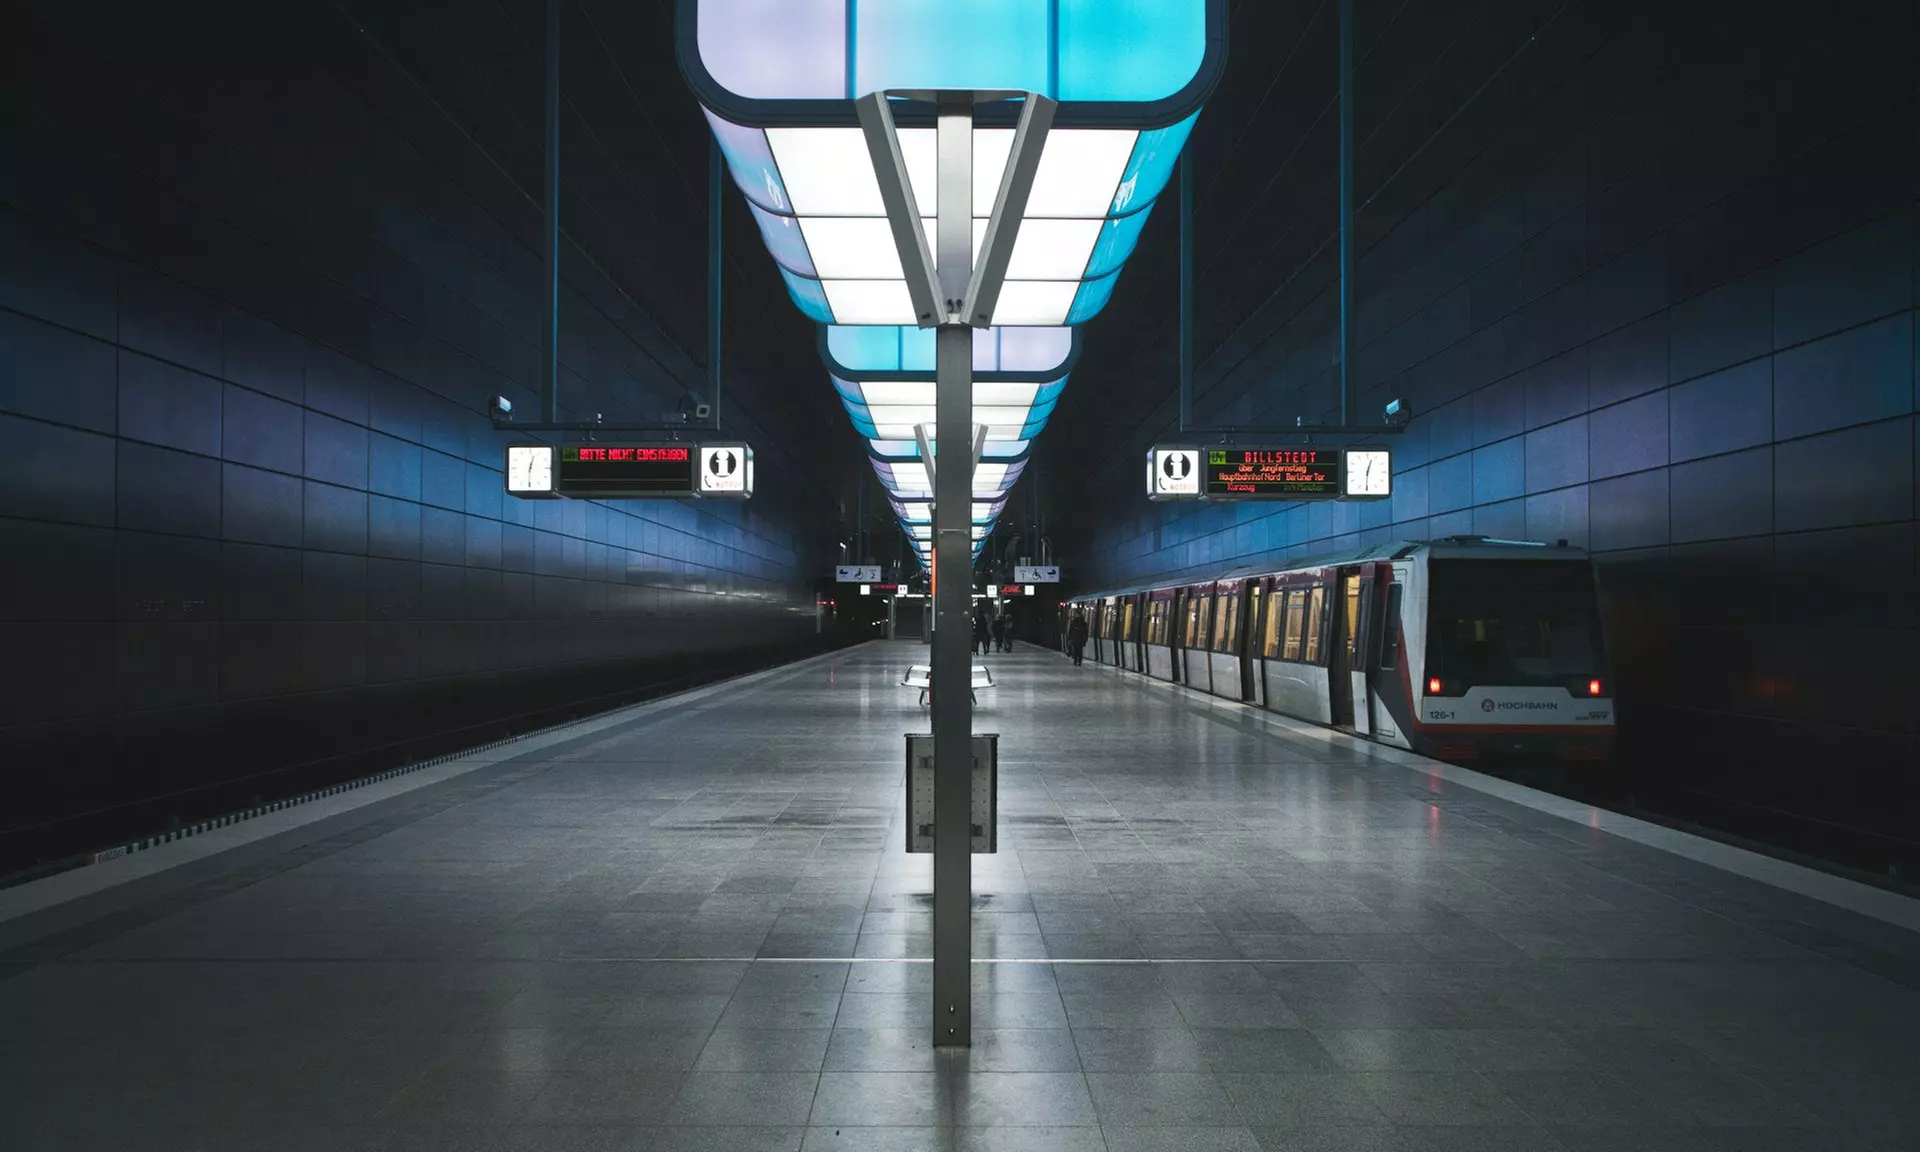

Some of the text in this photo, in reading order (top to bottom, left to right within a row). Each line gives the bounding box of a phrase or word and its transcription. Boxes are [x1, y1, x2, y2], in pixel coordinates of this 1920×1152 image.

[579, 448, 606, 461] BITTE
[608, 448, 635, 461] NICHT
[637, 448, 689, 461] EINSTEIGEN
[1244, 451, 1316, 463] BILLSTEDT
[1259, 463, 1307, 474] Jungfernstieg
[1218, 472, 1325, 482] Hauptbahnhof Nord Berliner Tor
[870, 572, 876, 580] 2
[1497, 702, 1558, 710] HOCHBAHN
[1430, 711, 1455, 720] 126-1
